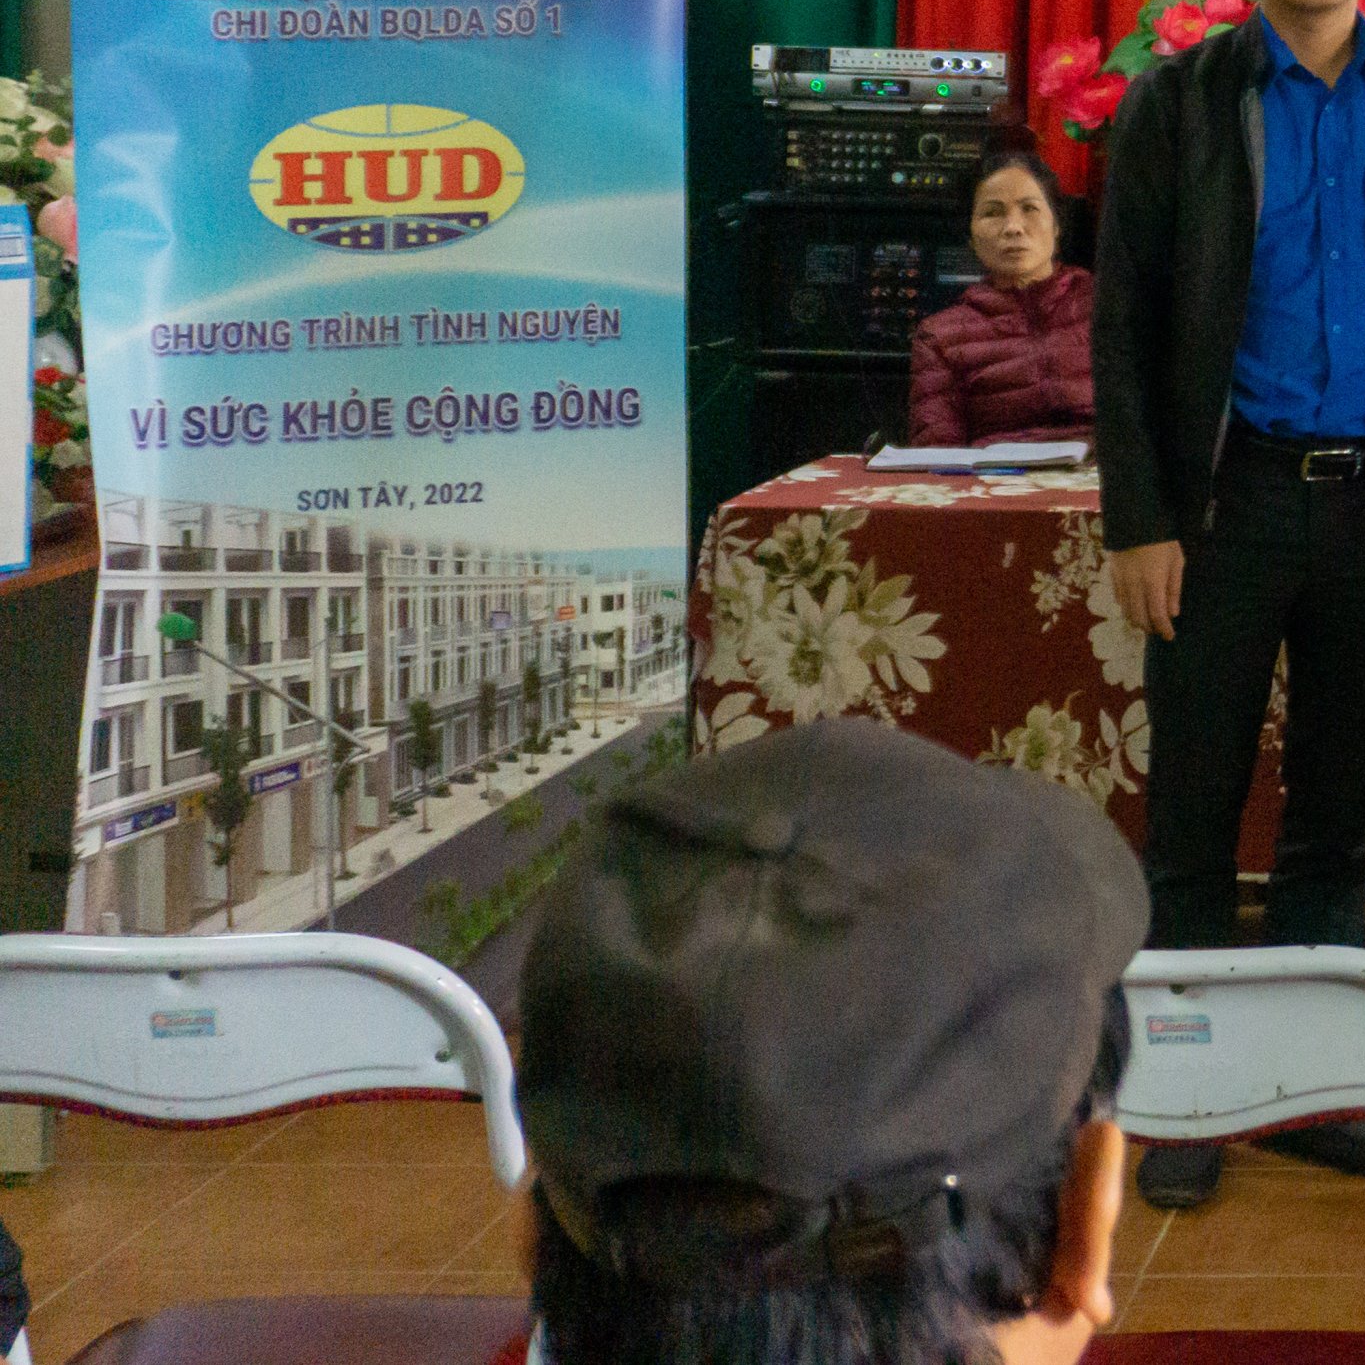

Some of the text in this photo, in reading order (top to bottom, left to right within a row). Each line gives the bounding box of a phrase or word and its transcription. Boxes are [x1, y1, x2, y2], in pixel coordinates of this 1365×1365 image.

[212, 10, 267, 39] CHI
[277, 1, 369, 39] ĐOÀN
[380, 6, 485, 41] BQLDA
[545, 5, 562, 34] 1
[272, 148, 503, 207] HUD
[150, 302, 620, 356] CHƯƠNG TRÌNH TÌNH NGUYỆN
[129, 379, 641, 446] VÌ SỨC KHỎE CỘNG ĐỒNG
[297, 481, 484, 513] SƠN TÂY, 2022
